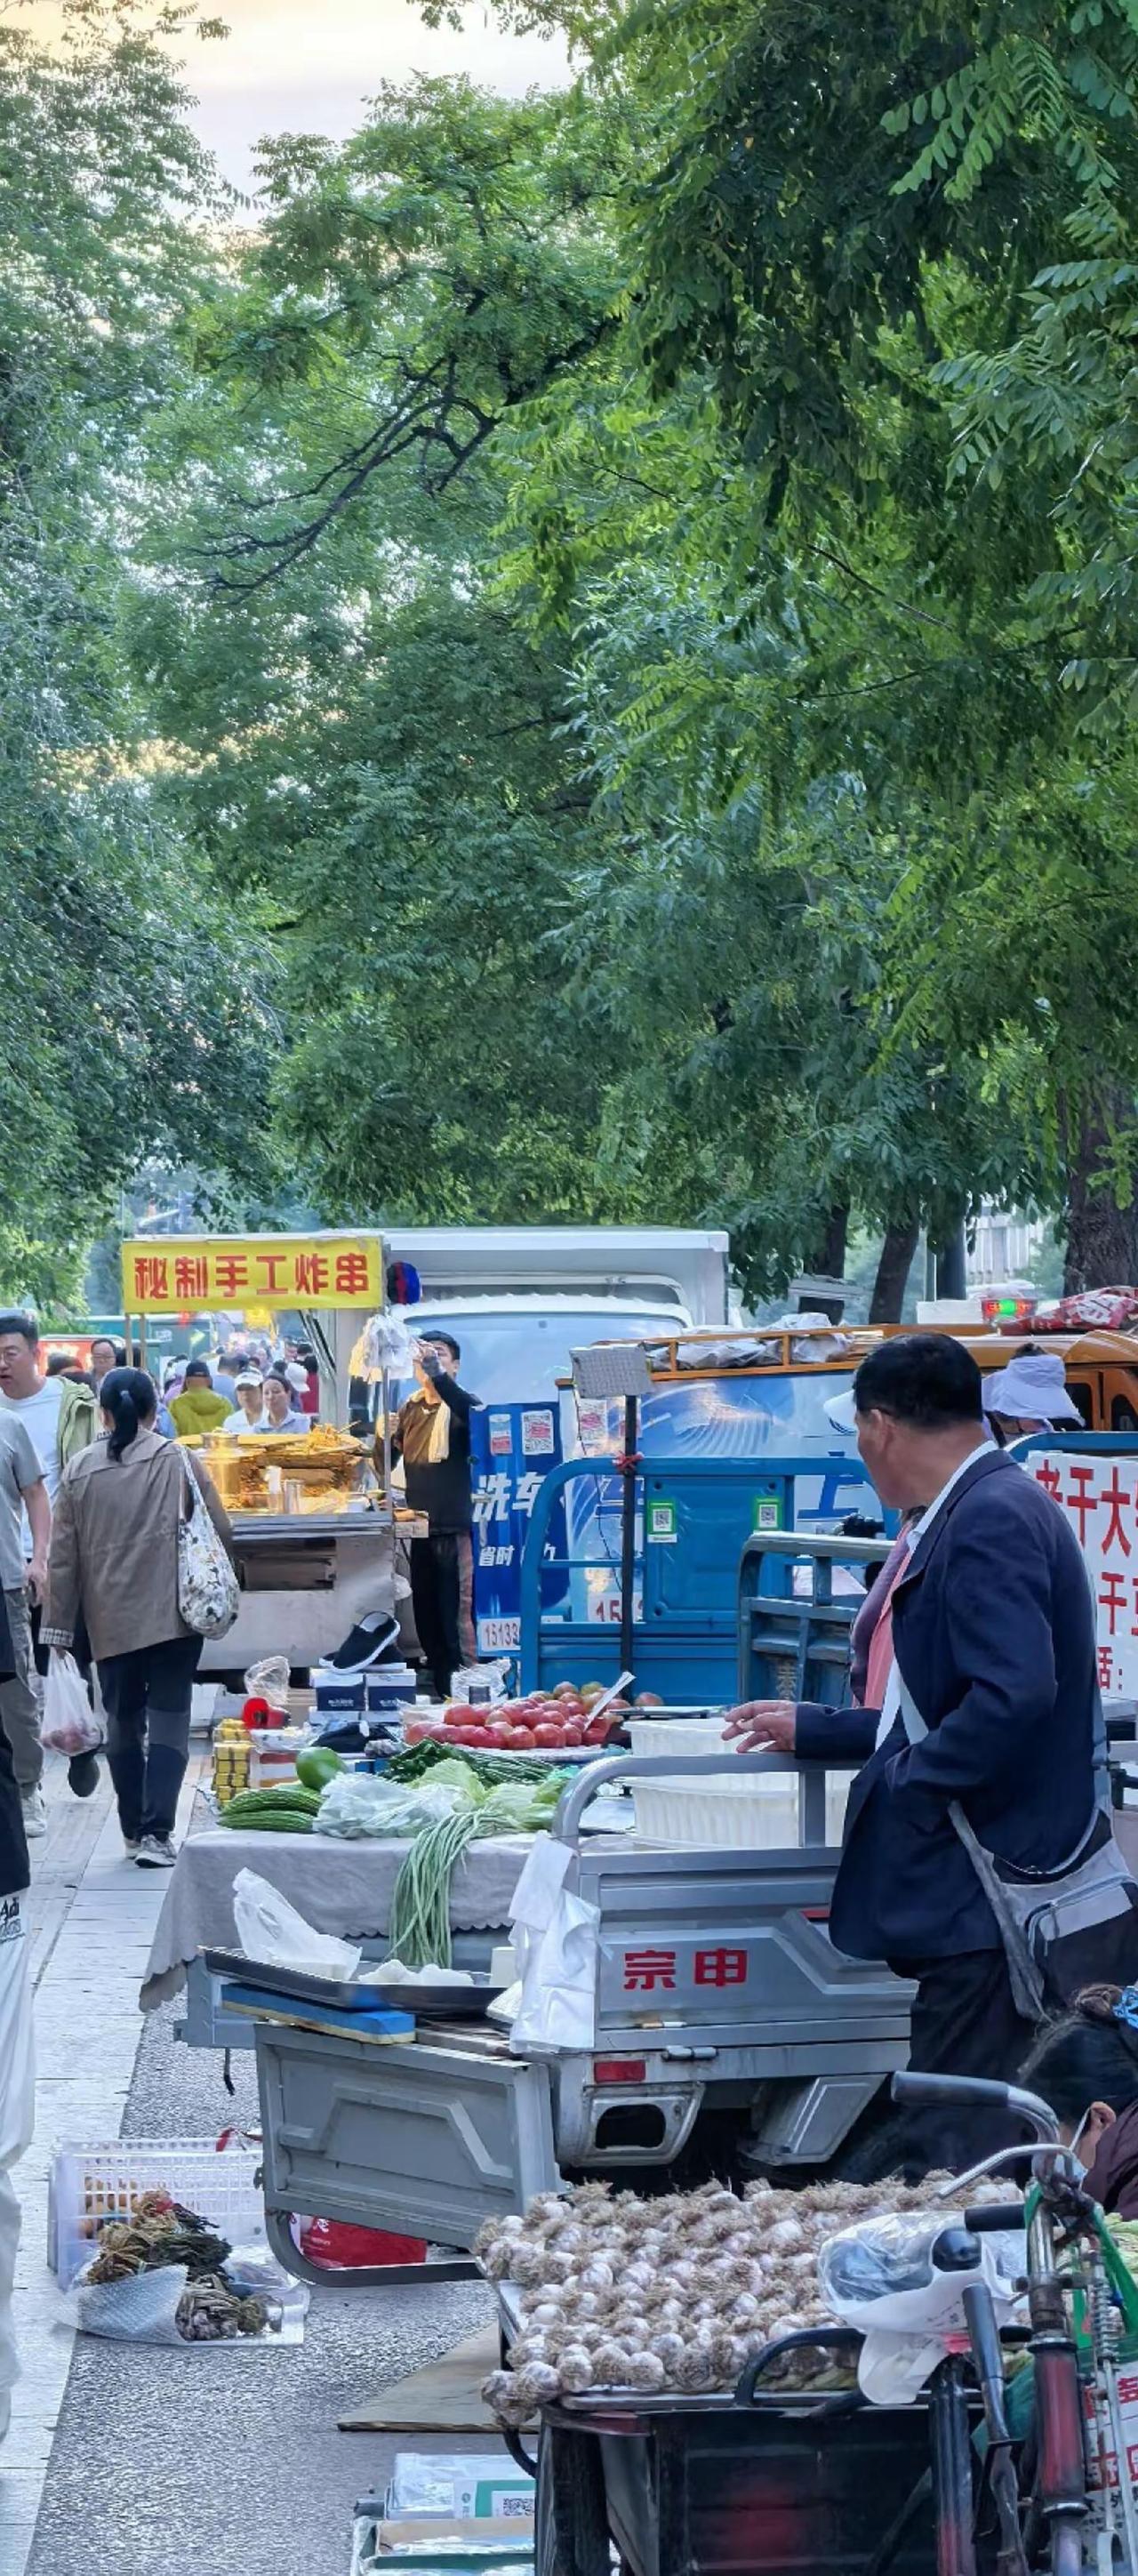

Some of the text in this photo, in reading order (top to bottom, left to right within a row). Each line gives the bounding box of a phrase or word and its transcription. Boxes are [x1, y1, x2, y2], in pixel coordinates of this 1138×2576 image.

[134, 1253, 369, 1299] 秘制手工炸串
[478, 1545, 515, 1567] 省时
[624, 1948, 748, 1990] 宗申
